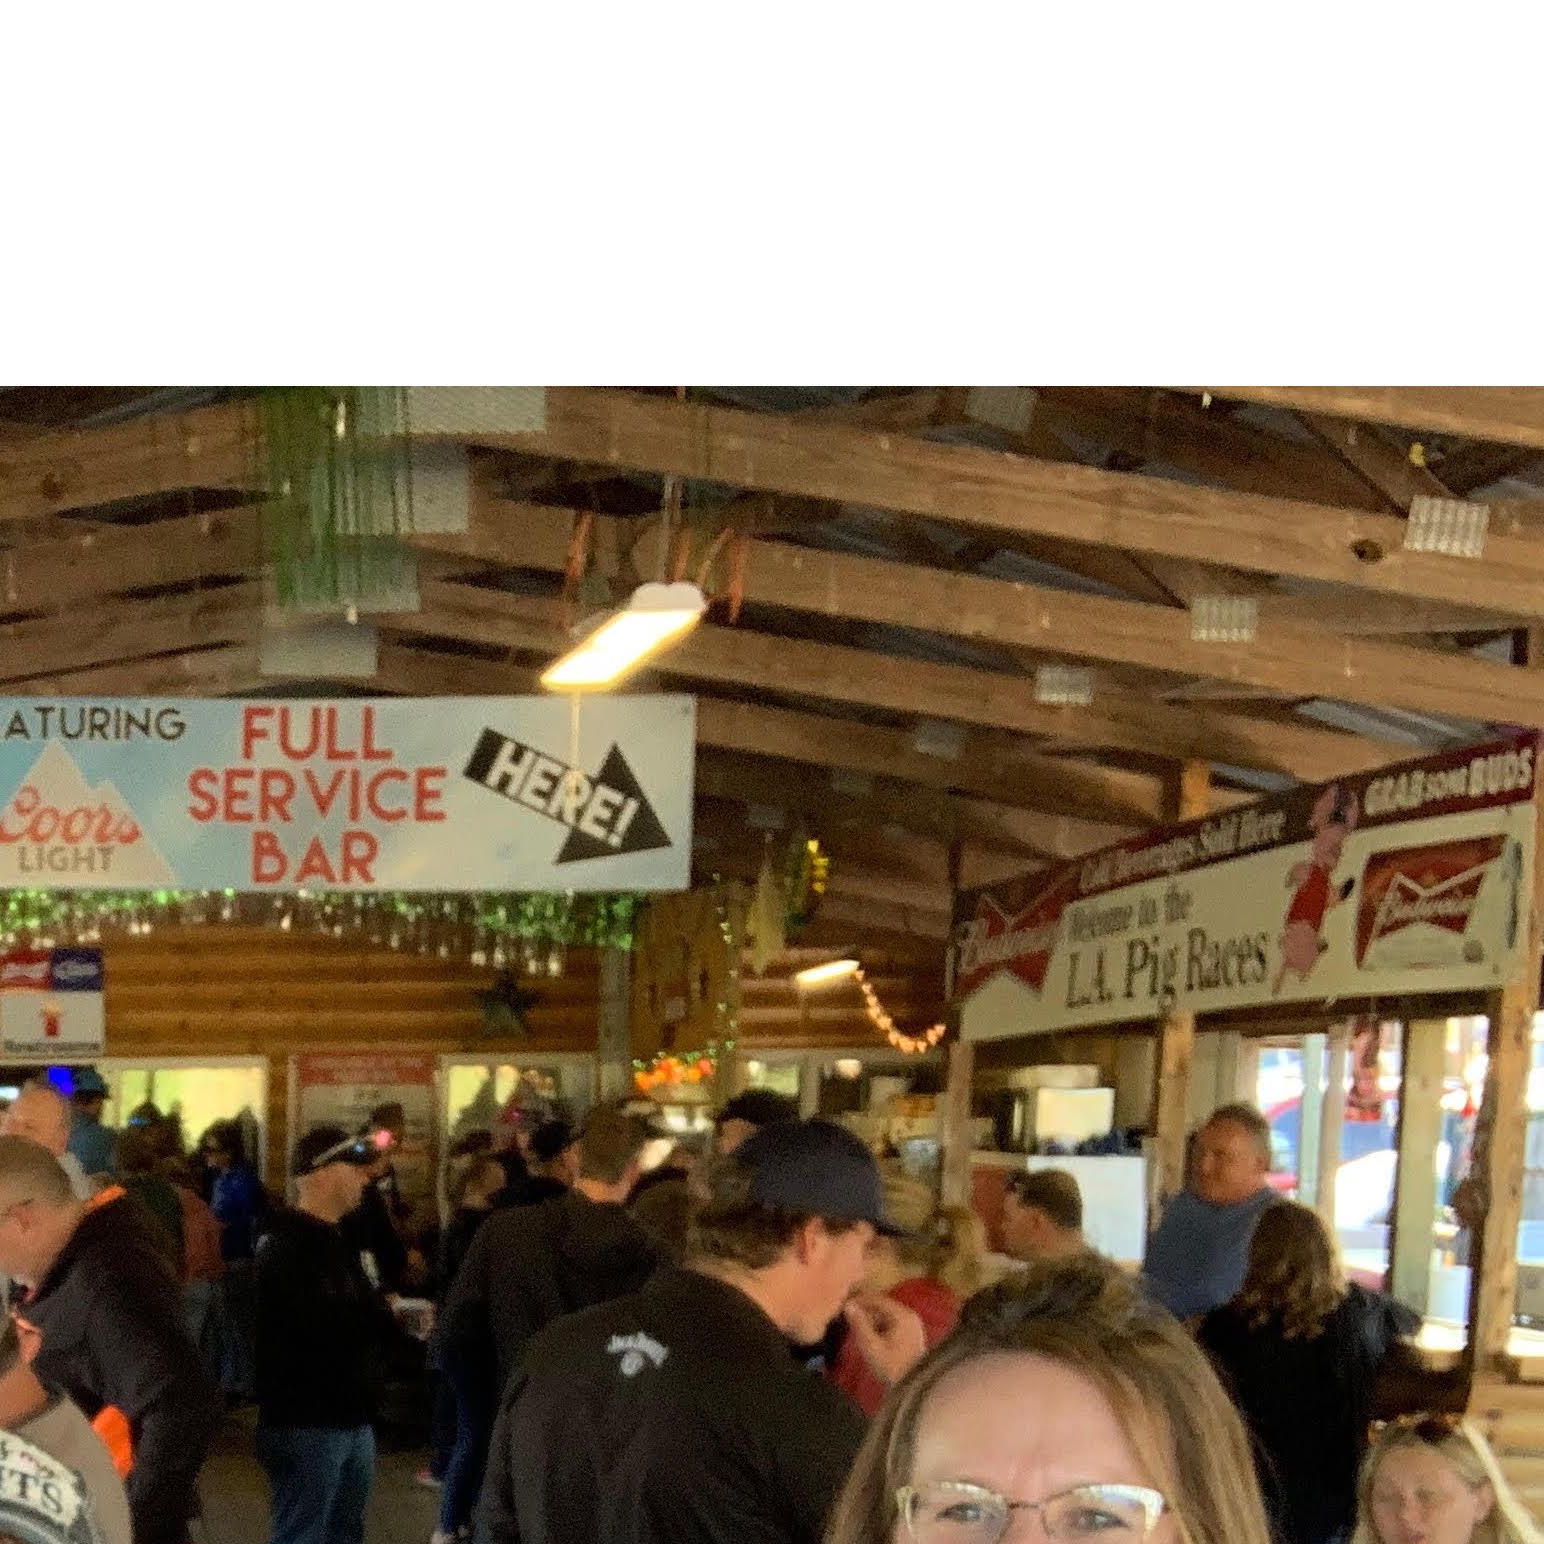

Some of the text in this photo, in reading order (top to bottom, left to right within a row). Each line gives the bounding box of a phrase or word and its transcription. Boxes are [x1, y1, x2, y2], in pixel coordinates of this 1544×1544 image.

[242, 705, 394, 761] FULL
[187, 766, 448, 823] SERVICE
[484, 739, 640, 848] HERE!
[1468, 749, 1533, 798] BUDS
[16, 846, 115, 873] LIGHT
[252, 830, 380, 884] BAR
[1123, 935, 1179, 1016] Pig
[1183, 927, 1271, 991] Races
